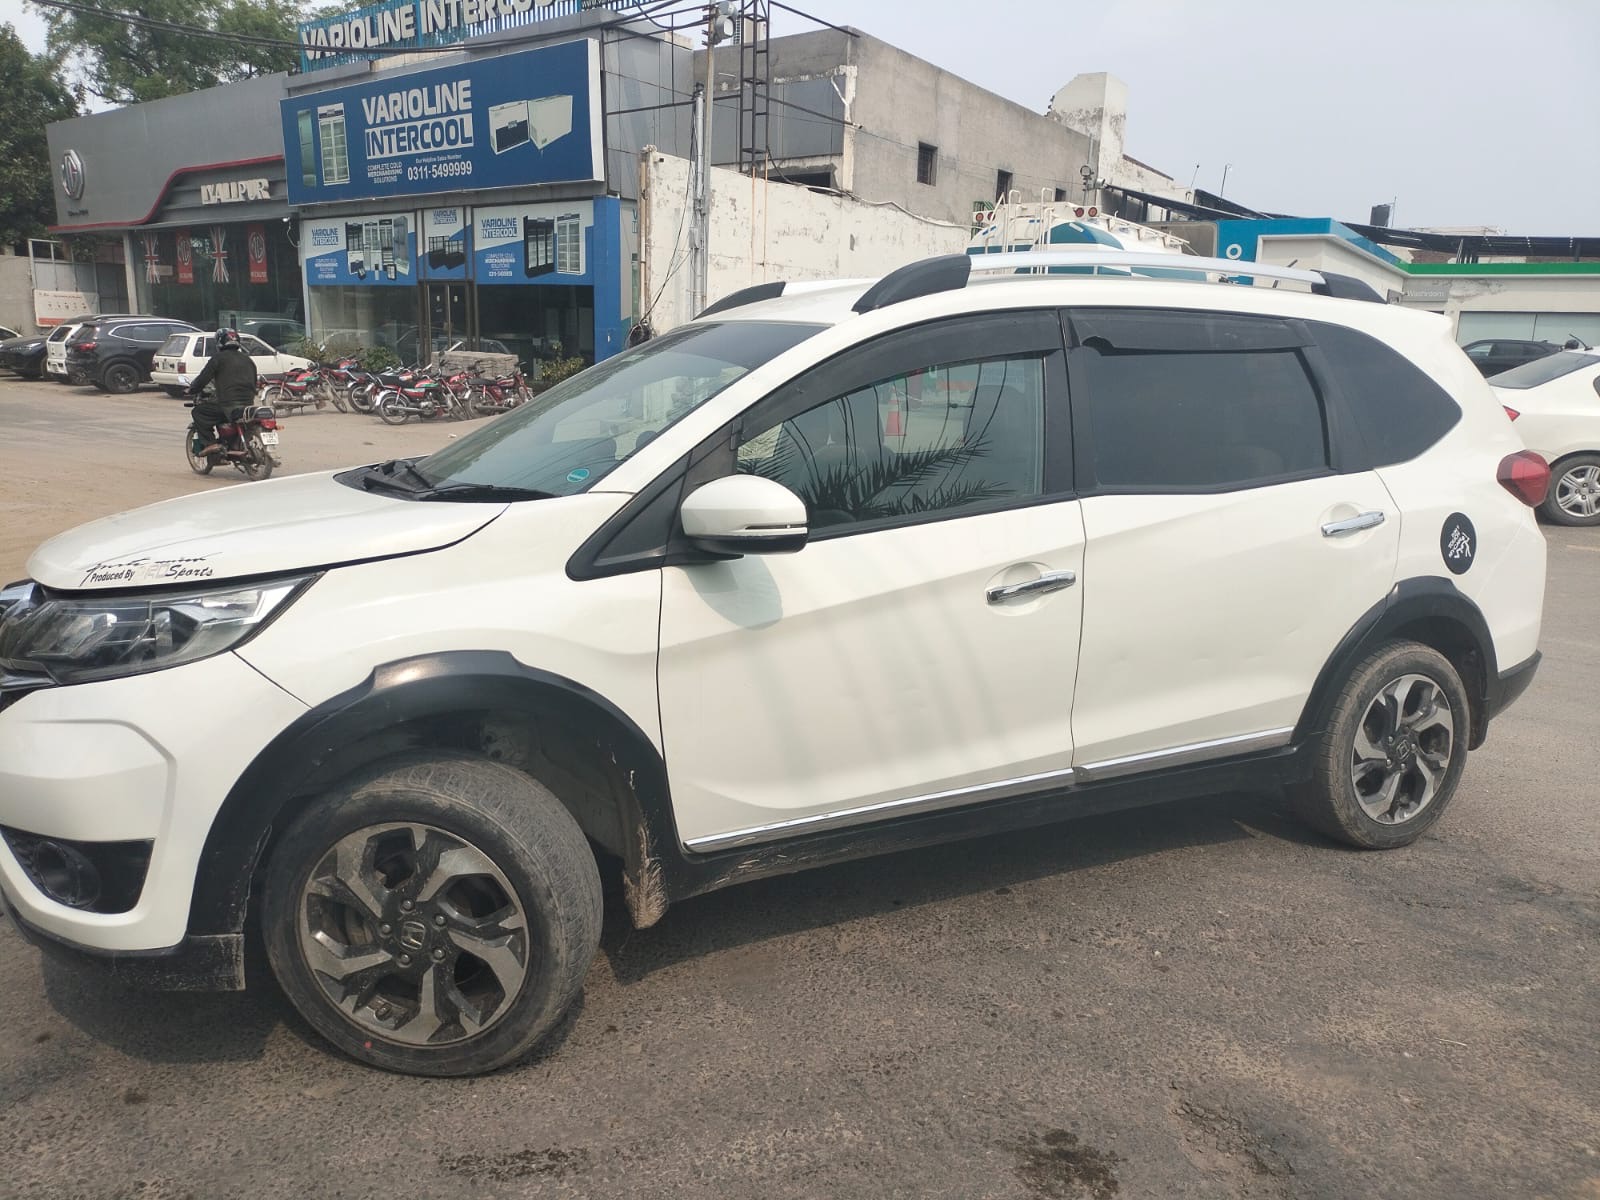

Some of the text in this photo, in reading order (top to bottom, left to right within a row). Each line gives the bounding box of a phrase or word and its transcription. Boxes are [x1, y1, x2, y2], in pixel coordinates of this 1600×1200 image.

[301, 4, 416, 60] VARIOLINE
[361, 80, 472, 125] VARIOLINE
[366, 117, 472, 157] INTERCOOL
[368, 163, 390, 171] COMPLETE
[407, 161, 472, 180] 0311-5499999
[374, 176, 397, 184] SOLUTIONS
[433, 209, 457, 217] VARIOLINE
[482, 218, 517, 228] VARIOLINE
[312, 228, 338, 236] VARIOLINE
[482, 227, 517, 238] INTERCOOL
[312, 236, 339, 246] INTERCOOL
[90, 569, 124, 582] Produced
[124, 568, 136, 581] By
[165, 564, 213, 579] Sports
